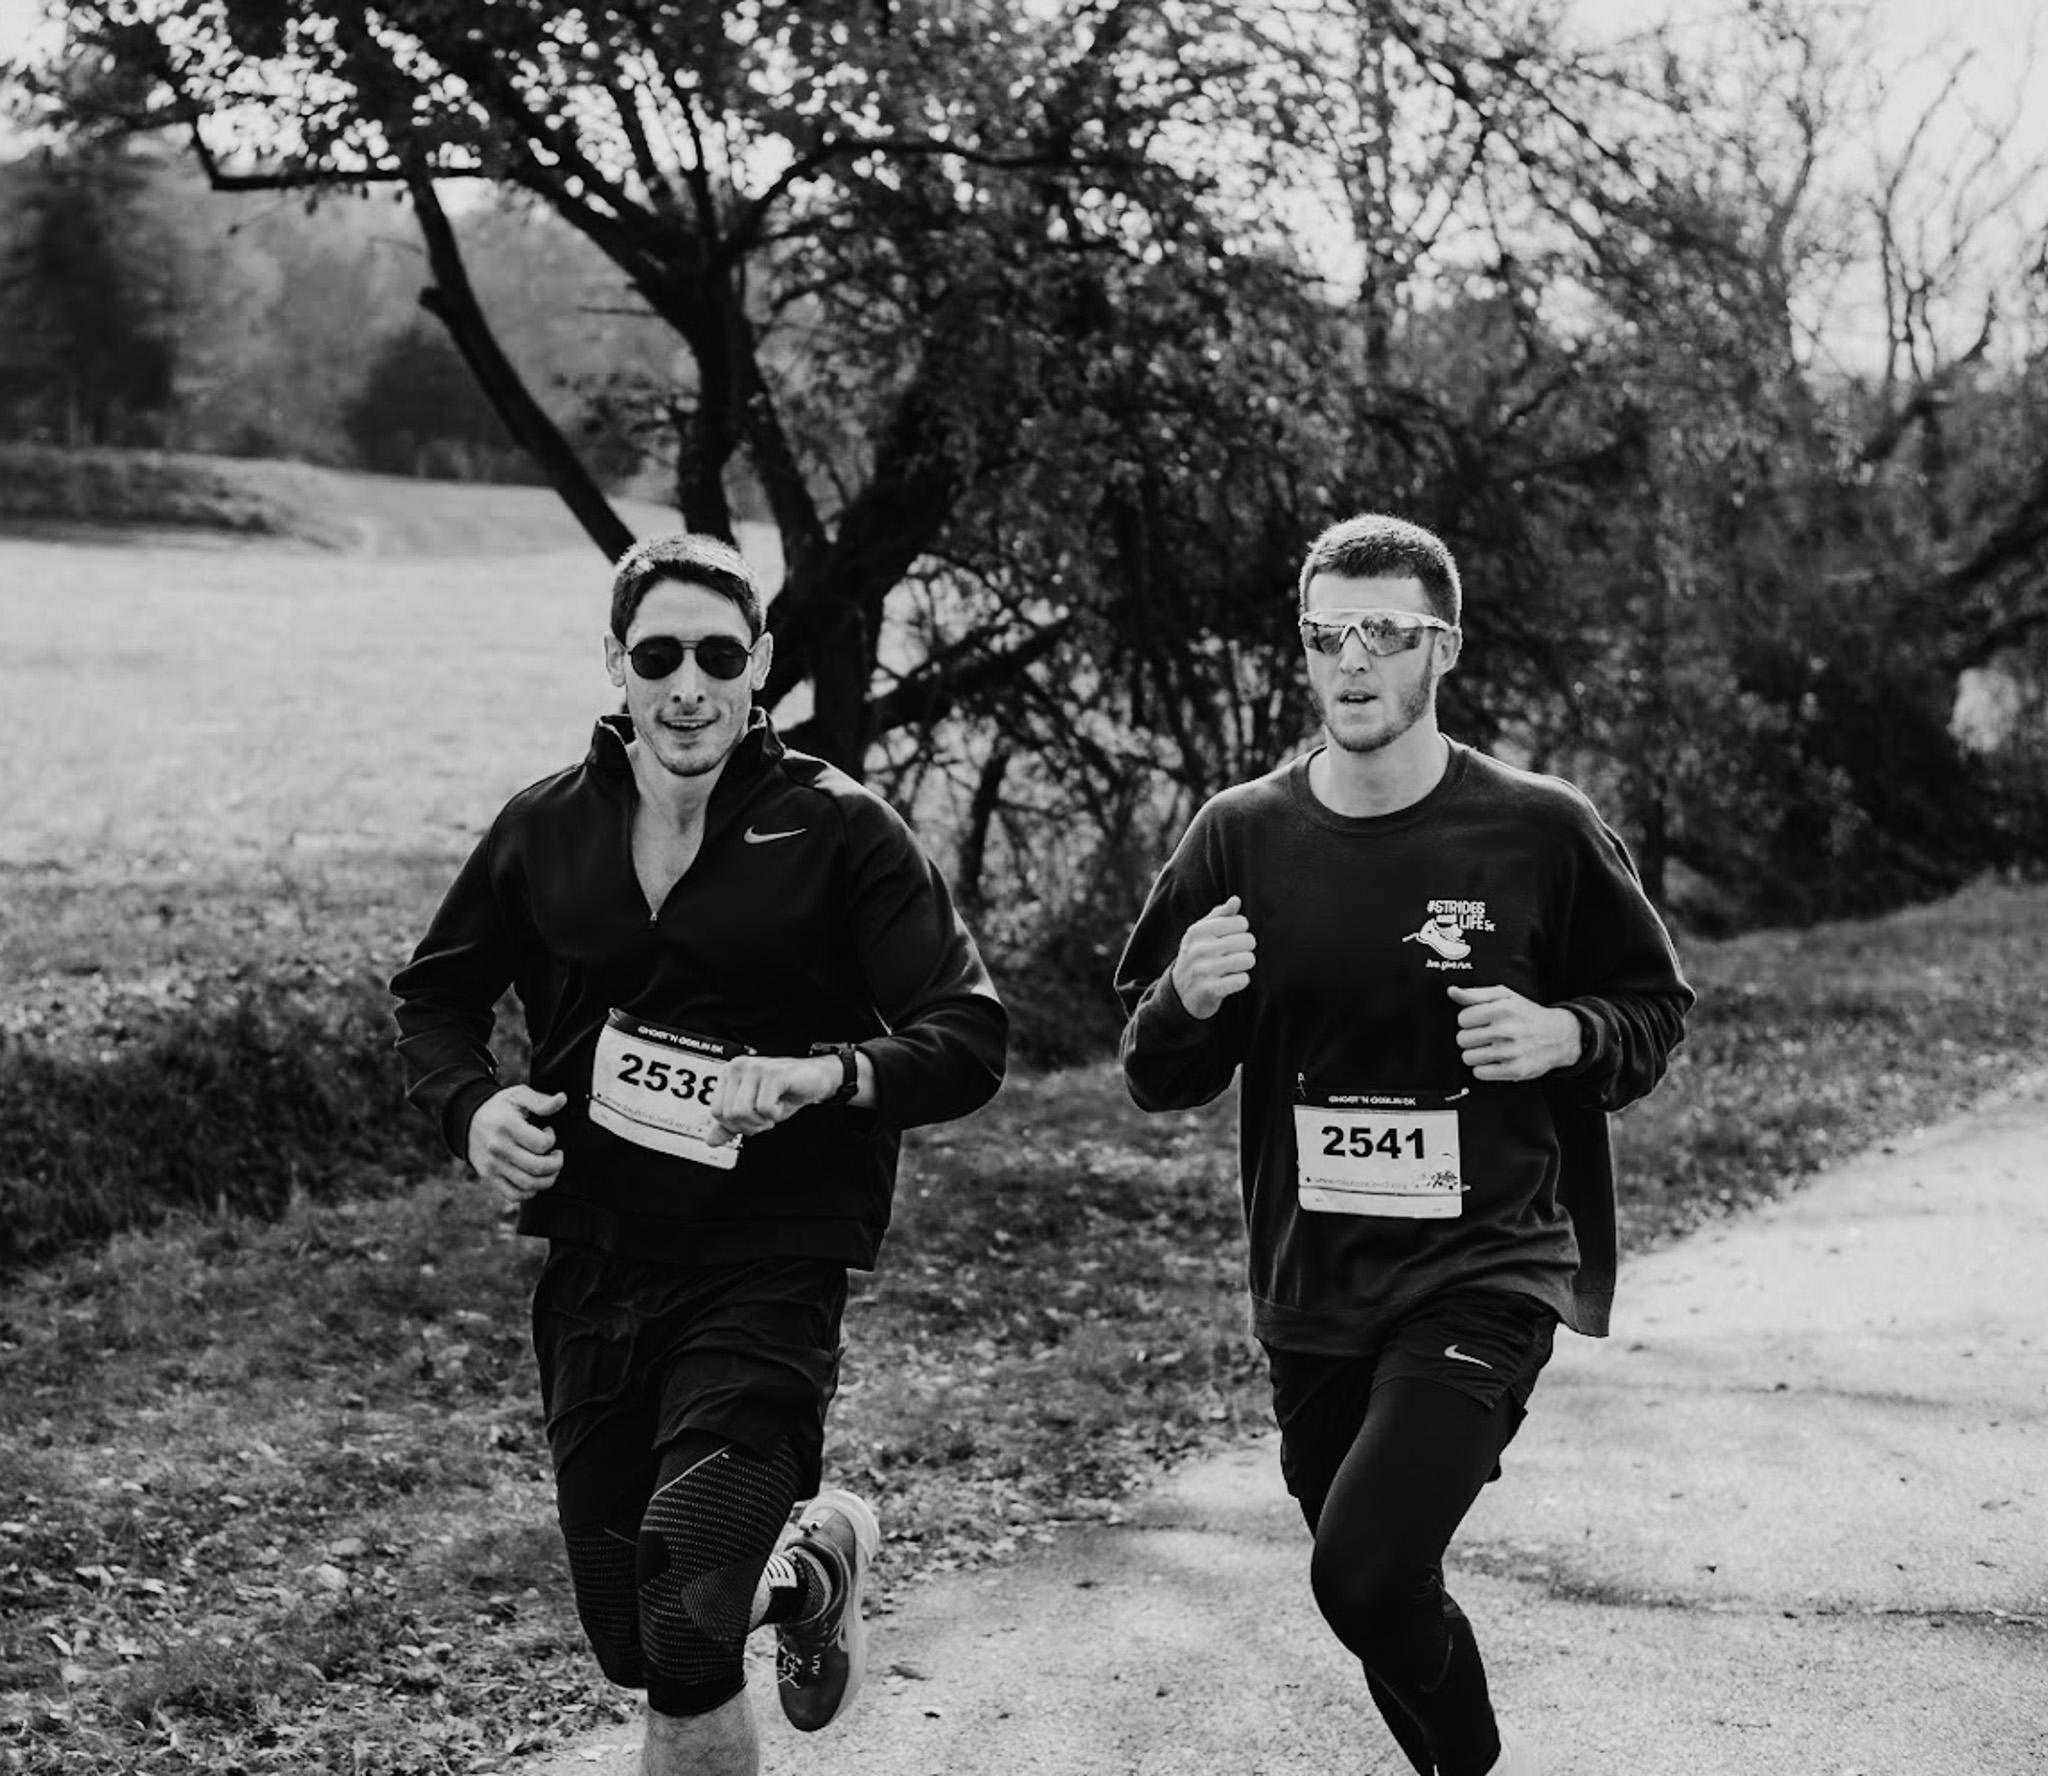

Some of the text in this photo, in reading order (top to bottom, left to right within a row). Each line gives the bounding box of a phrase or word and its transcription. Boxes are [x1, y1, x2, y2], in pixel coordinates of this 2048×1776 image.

[1426, 899, 1486, 914] #STRIDES
[1459, 914, 1485, 930] LIFE
[617, 1052, 718, 1106] 2538
[1321, 1125, 1425, 1160] 2541
